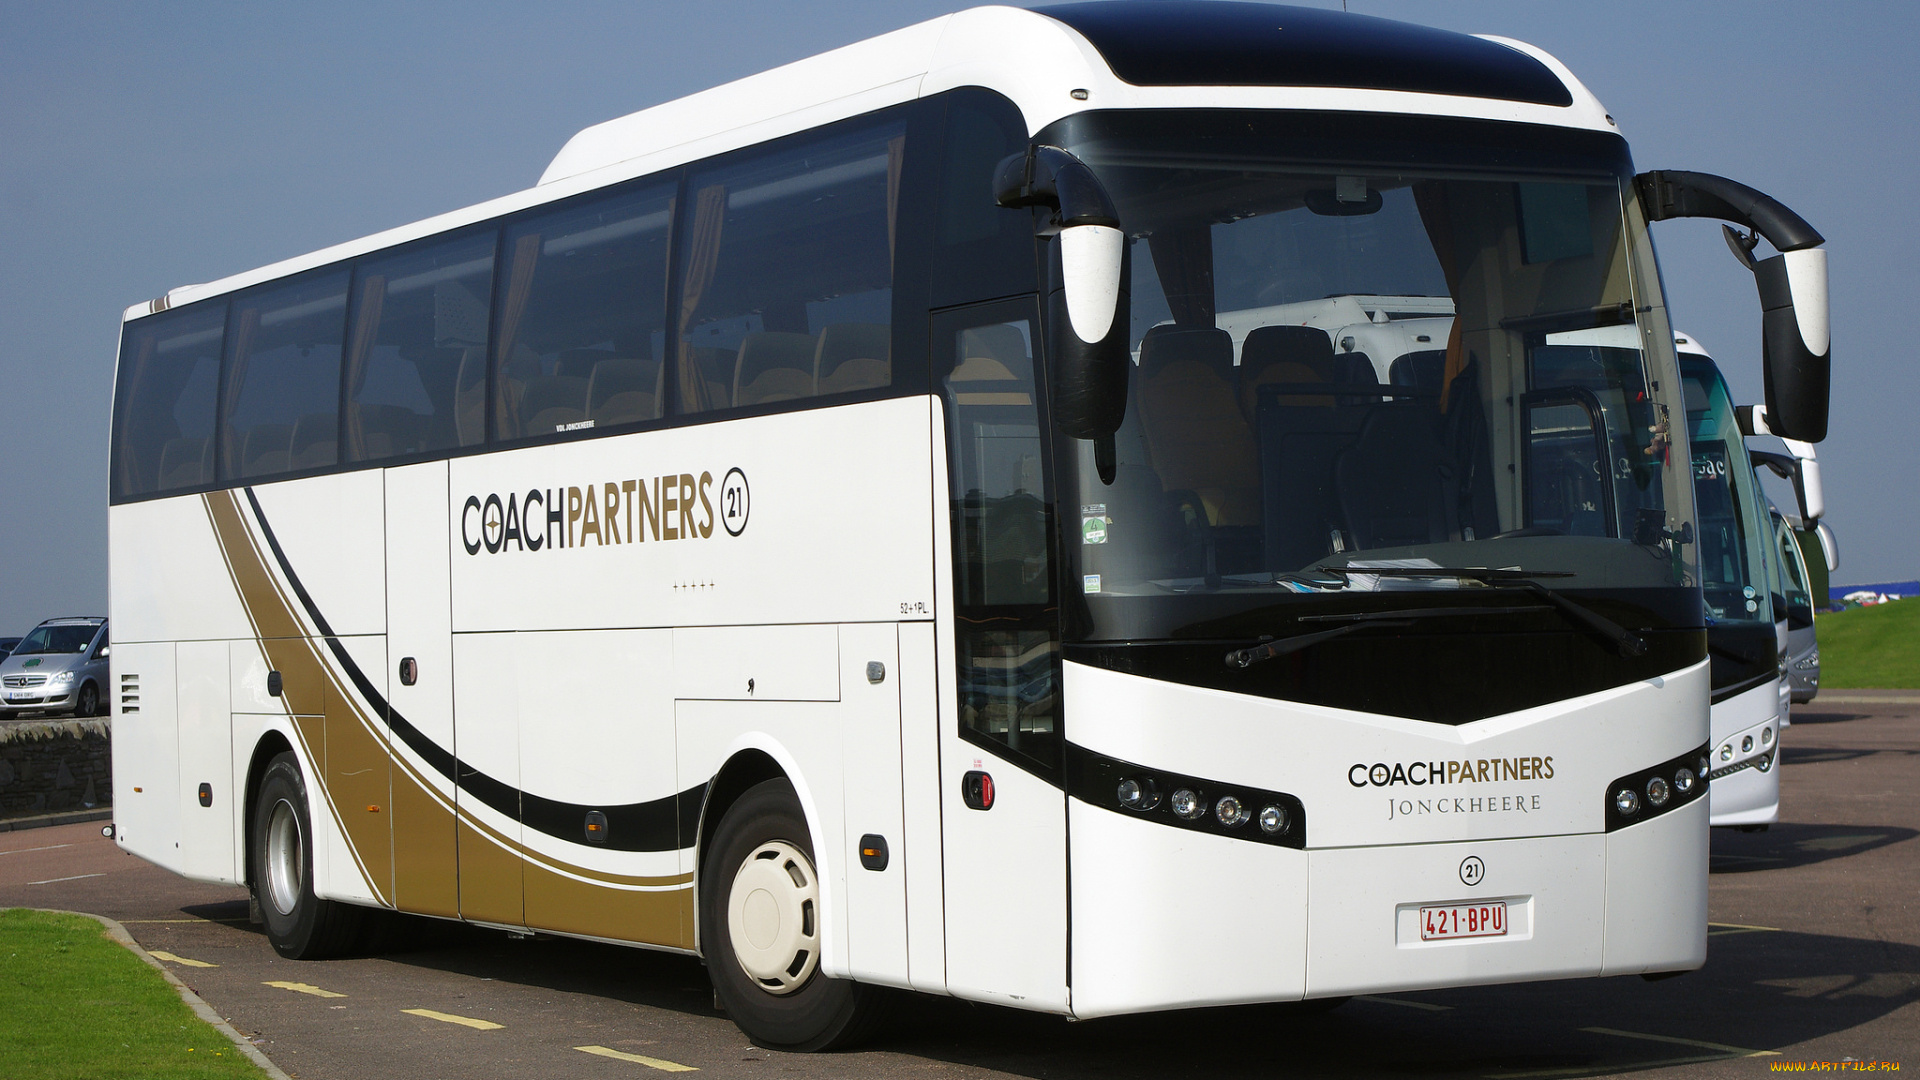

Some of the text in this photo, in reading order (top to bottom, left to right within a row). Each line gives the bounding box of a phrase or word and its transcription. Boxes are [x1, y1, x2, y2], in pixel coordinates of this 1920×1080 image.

[727, 487, 742, 518] 21
[1388, 795, 1541, 820] JONCKHEERE
[1465, 864, 1479, 878] 21
